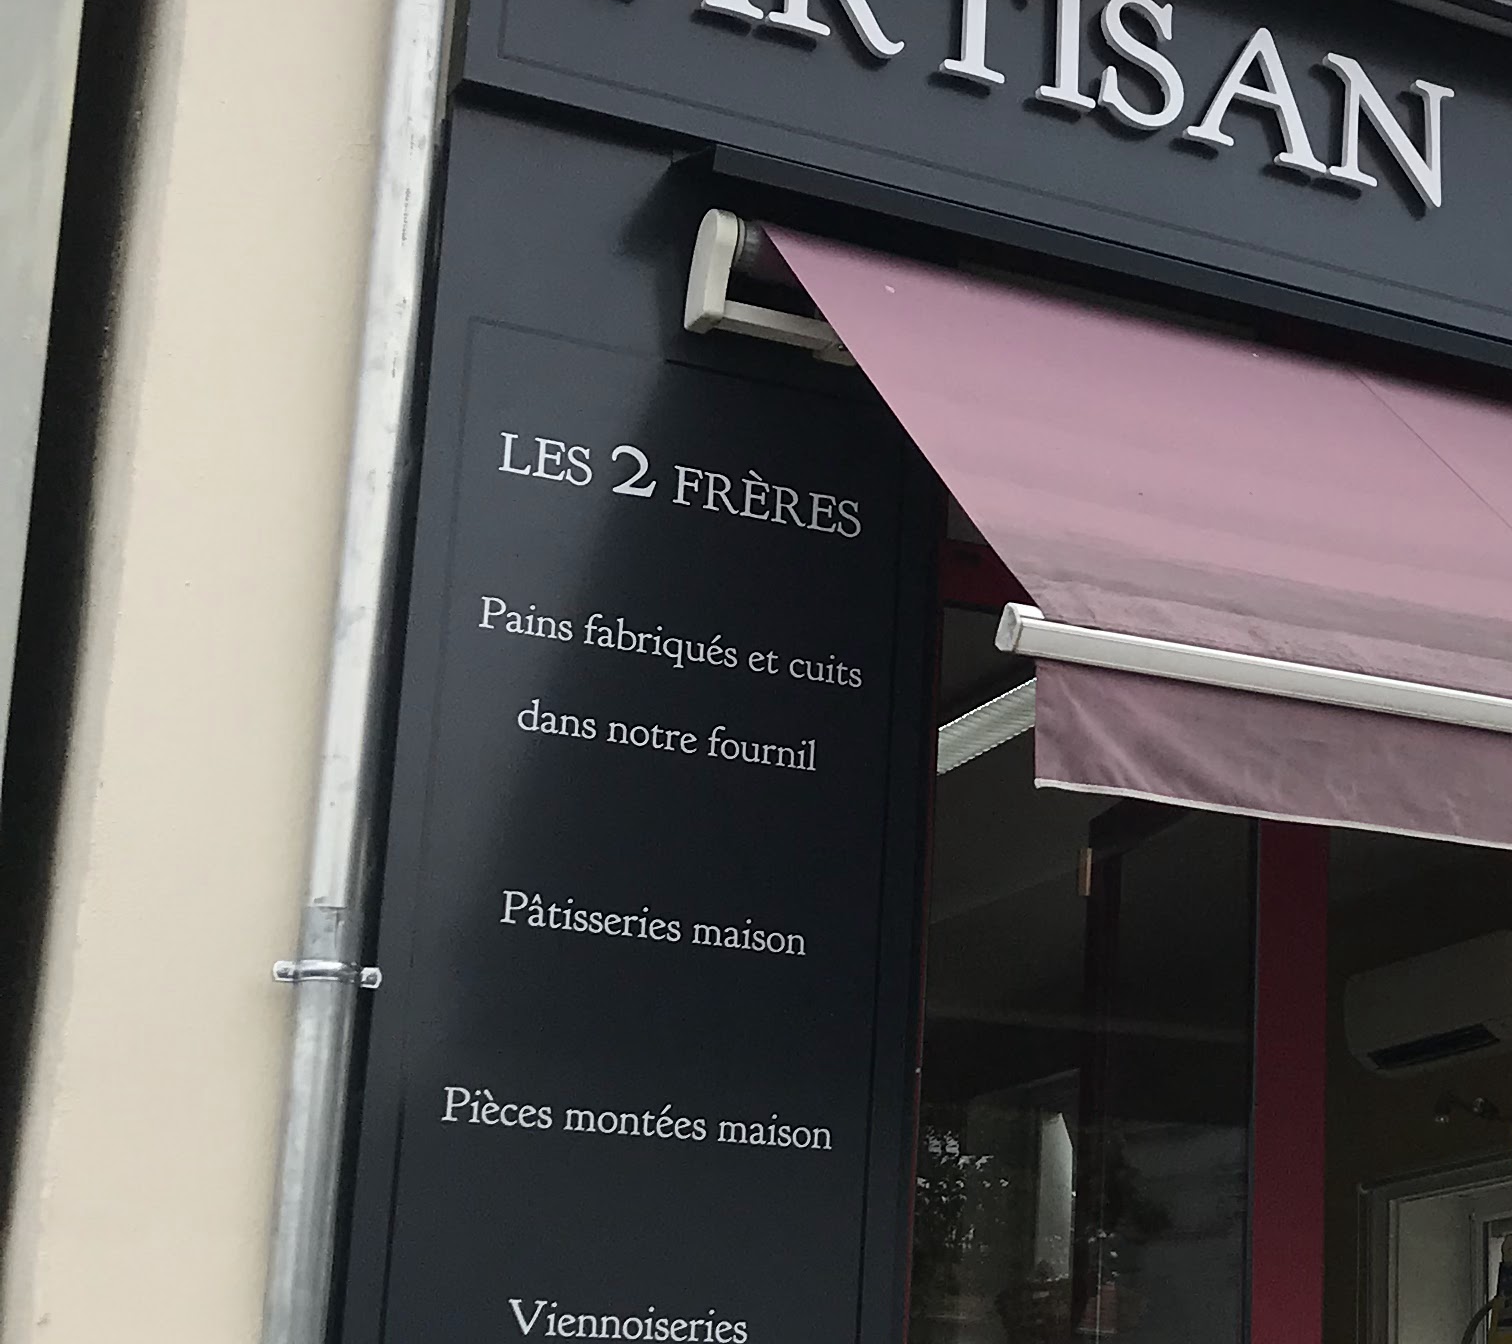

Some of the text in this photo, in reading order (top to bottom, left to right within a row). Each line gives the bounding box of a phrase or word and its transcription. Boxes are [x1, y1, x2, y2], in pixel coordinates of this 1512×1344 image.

[498, 431, 862, 538] LES 2 FRÈRES
[478, 595, 863, 688] Pains fabriqués et cuits
[517, 698, 817, 772] dans notre fournil
[499, 889, 807, 956] Pâtisseries maison
[440, 1086, 833, 1151] Pièces montées maison
[508, 1298, 748, 1344] Viennoiseries
